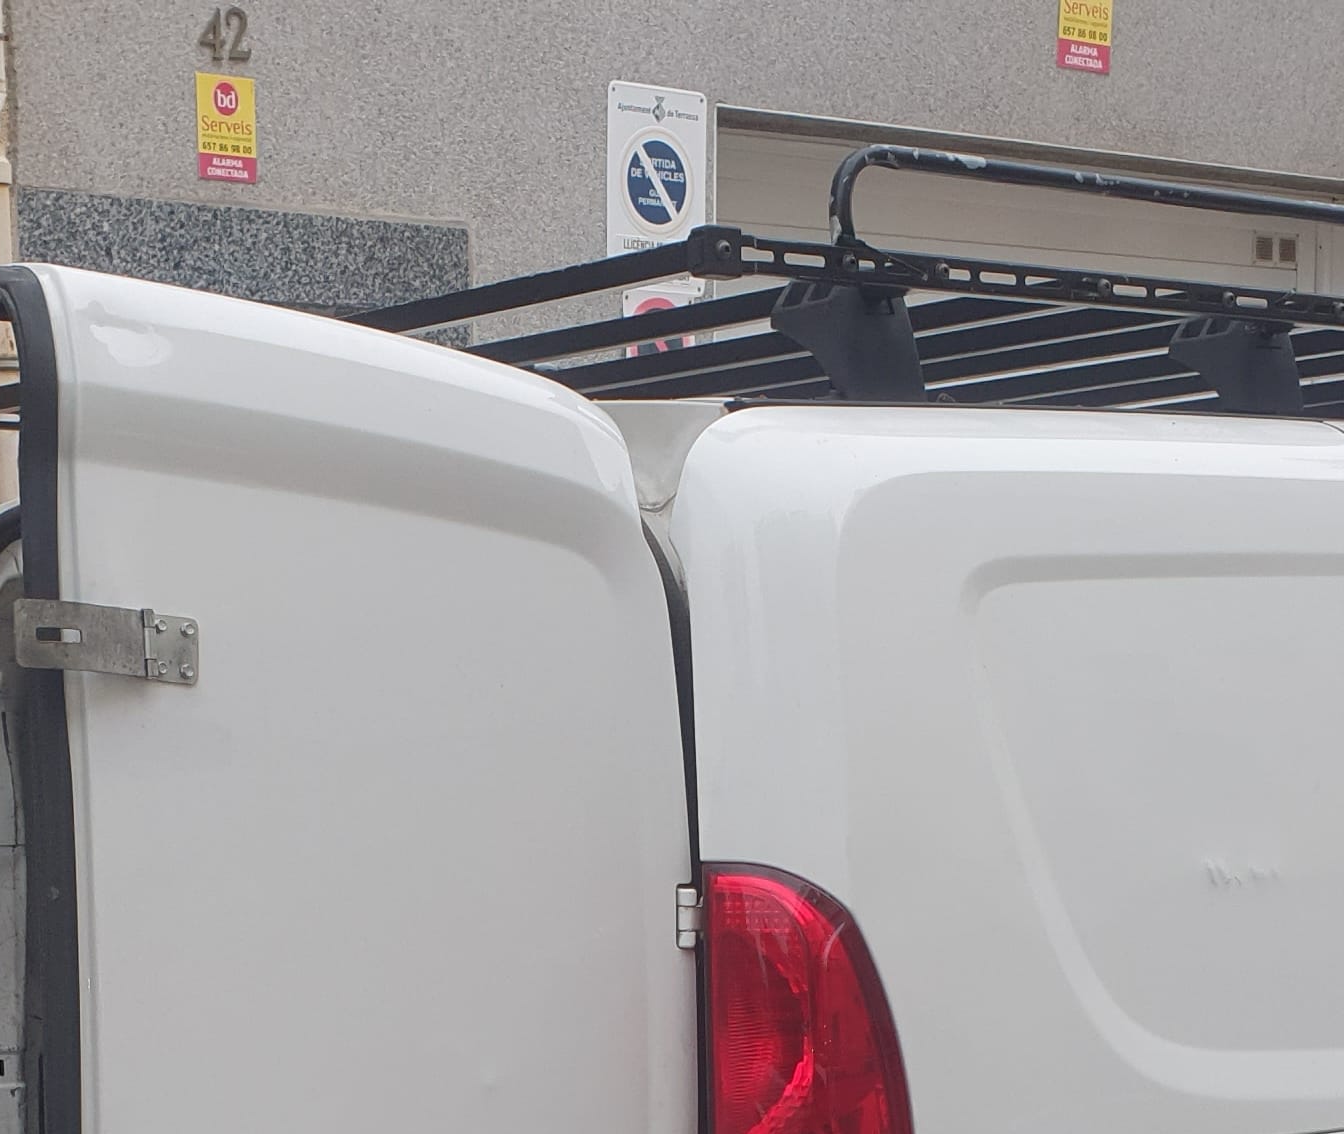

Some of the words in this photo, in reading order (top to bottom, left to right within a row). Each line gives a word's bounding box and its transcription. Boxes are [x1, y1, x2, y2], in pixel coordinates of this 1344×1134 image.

[198, 6, 253, 62] 42
[216, 88, 236, 109] bd
[201, 115, 253, 136] Serveis
[630, 167, 643, 177] DE
